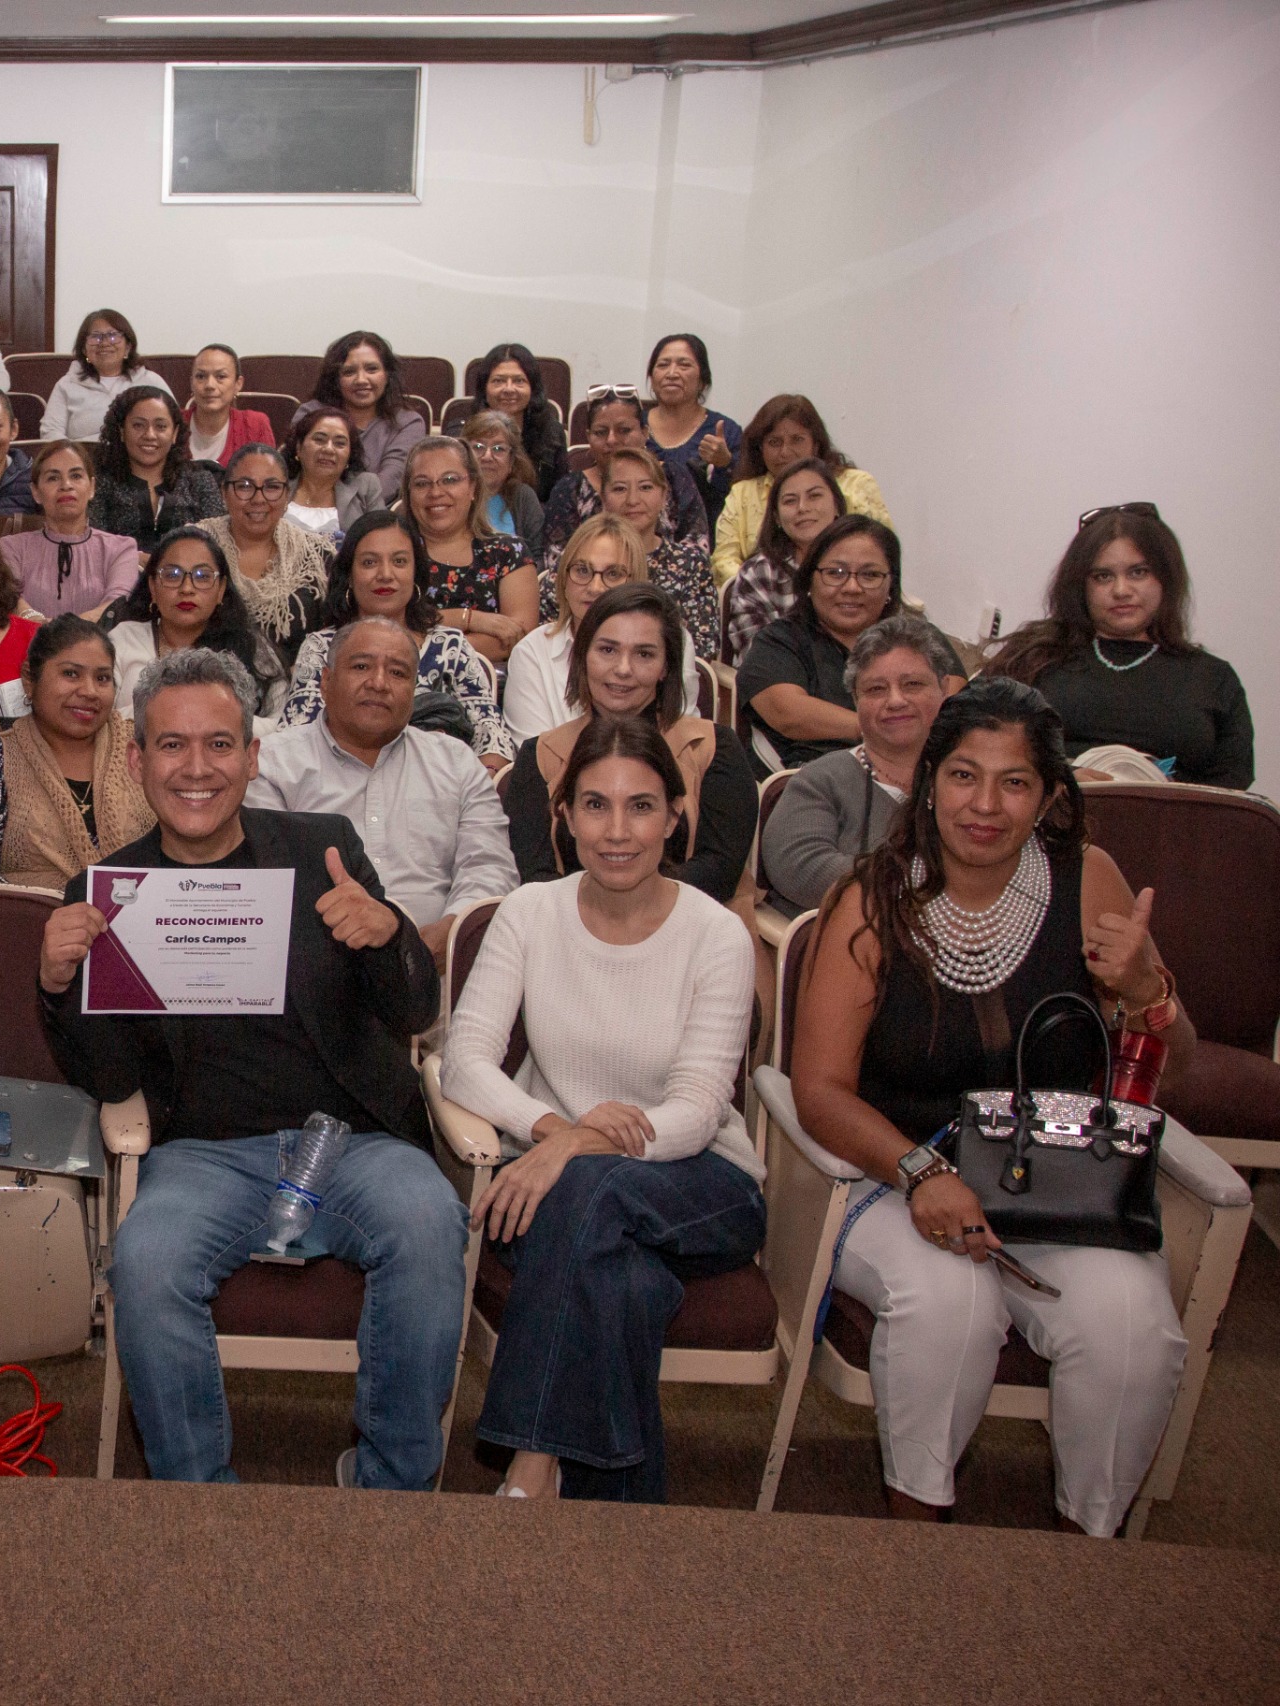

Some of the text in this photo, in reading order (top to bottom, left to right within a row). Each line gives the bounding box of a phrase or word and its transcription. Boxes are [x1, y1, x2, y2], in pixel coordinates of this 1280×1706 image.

[155, 918, 264, 926] RECONOCIMIENTO
[165, 935, 247, 945] Carlos Campos
